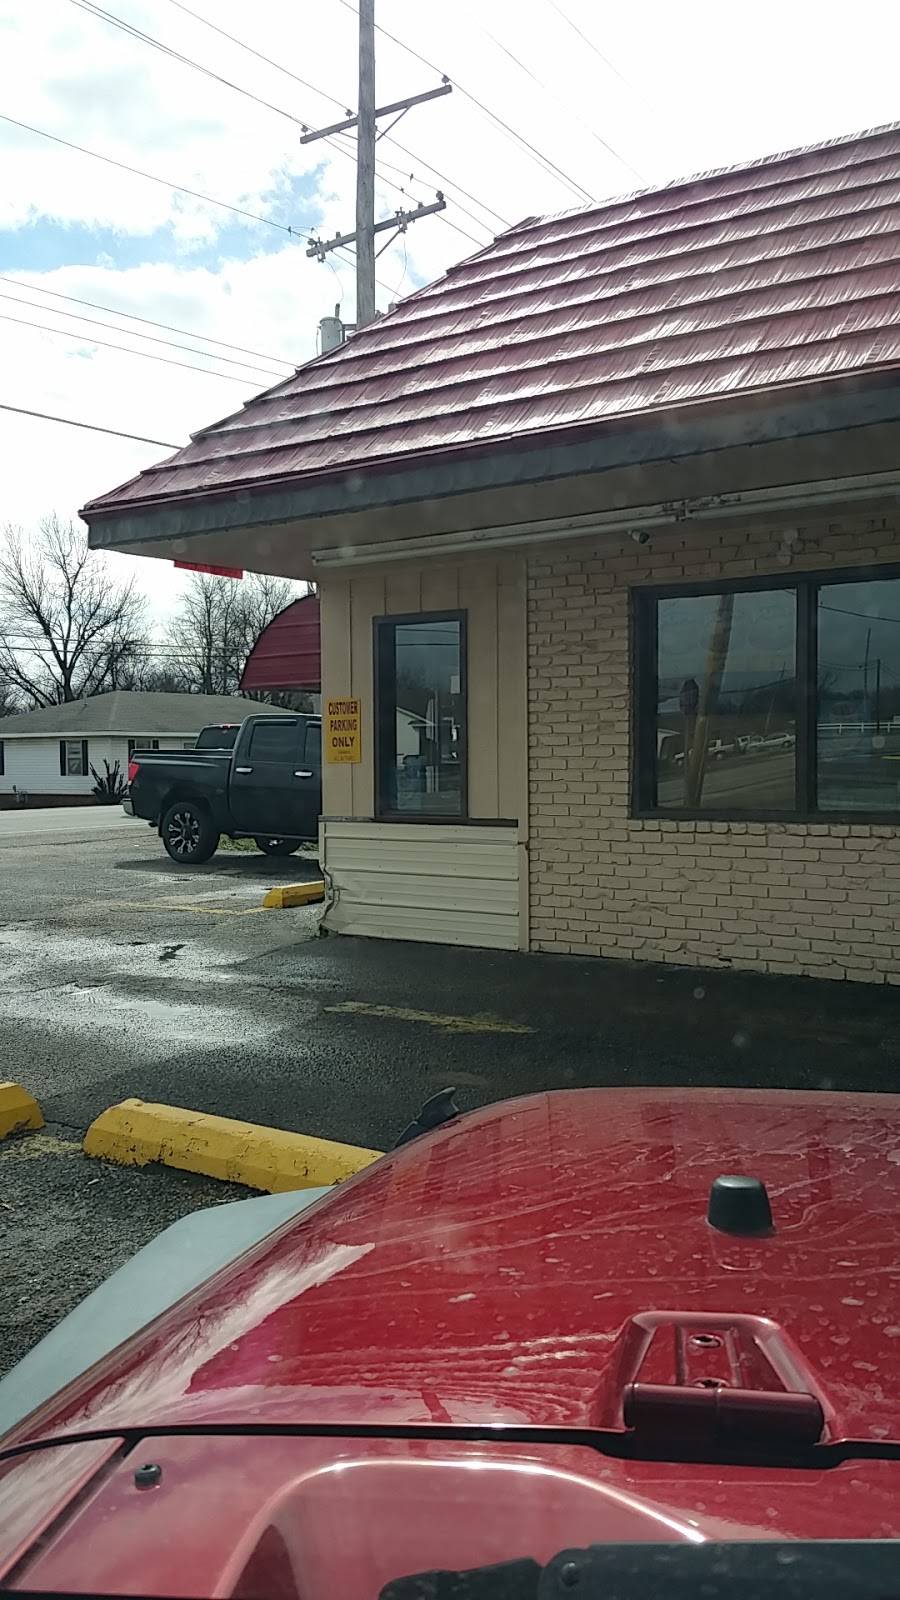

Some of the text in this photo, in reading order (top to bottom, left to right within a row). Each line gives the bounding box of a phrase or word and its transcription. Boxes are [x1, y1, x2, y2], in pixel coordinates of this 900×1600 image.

[328, 701, 358, 715] CUSTOMER
[330, 719, 357, 732] PARKING
[332, 736, 355, 748] ONLY
